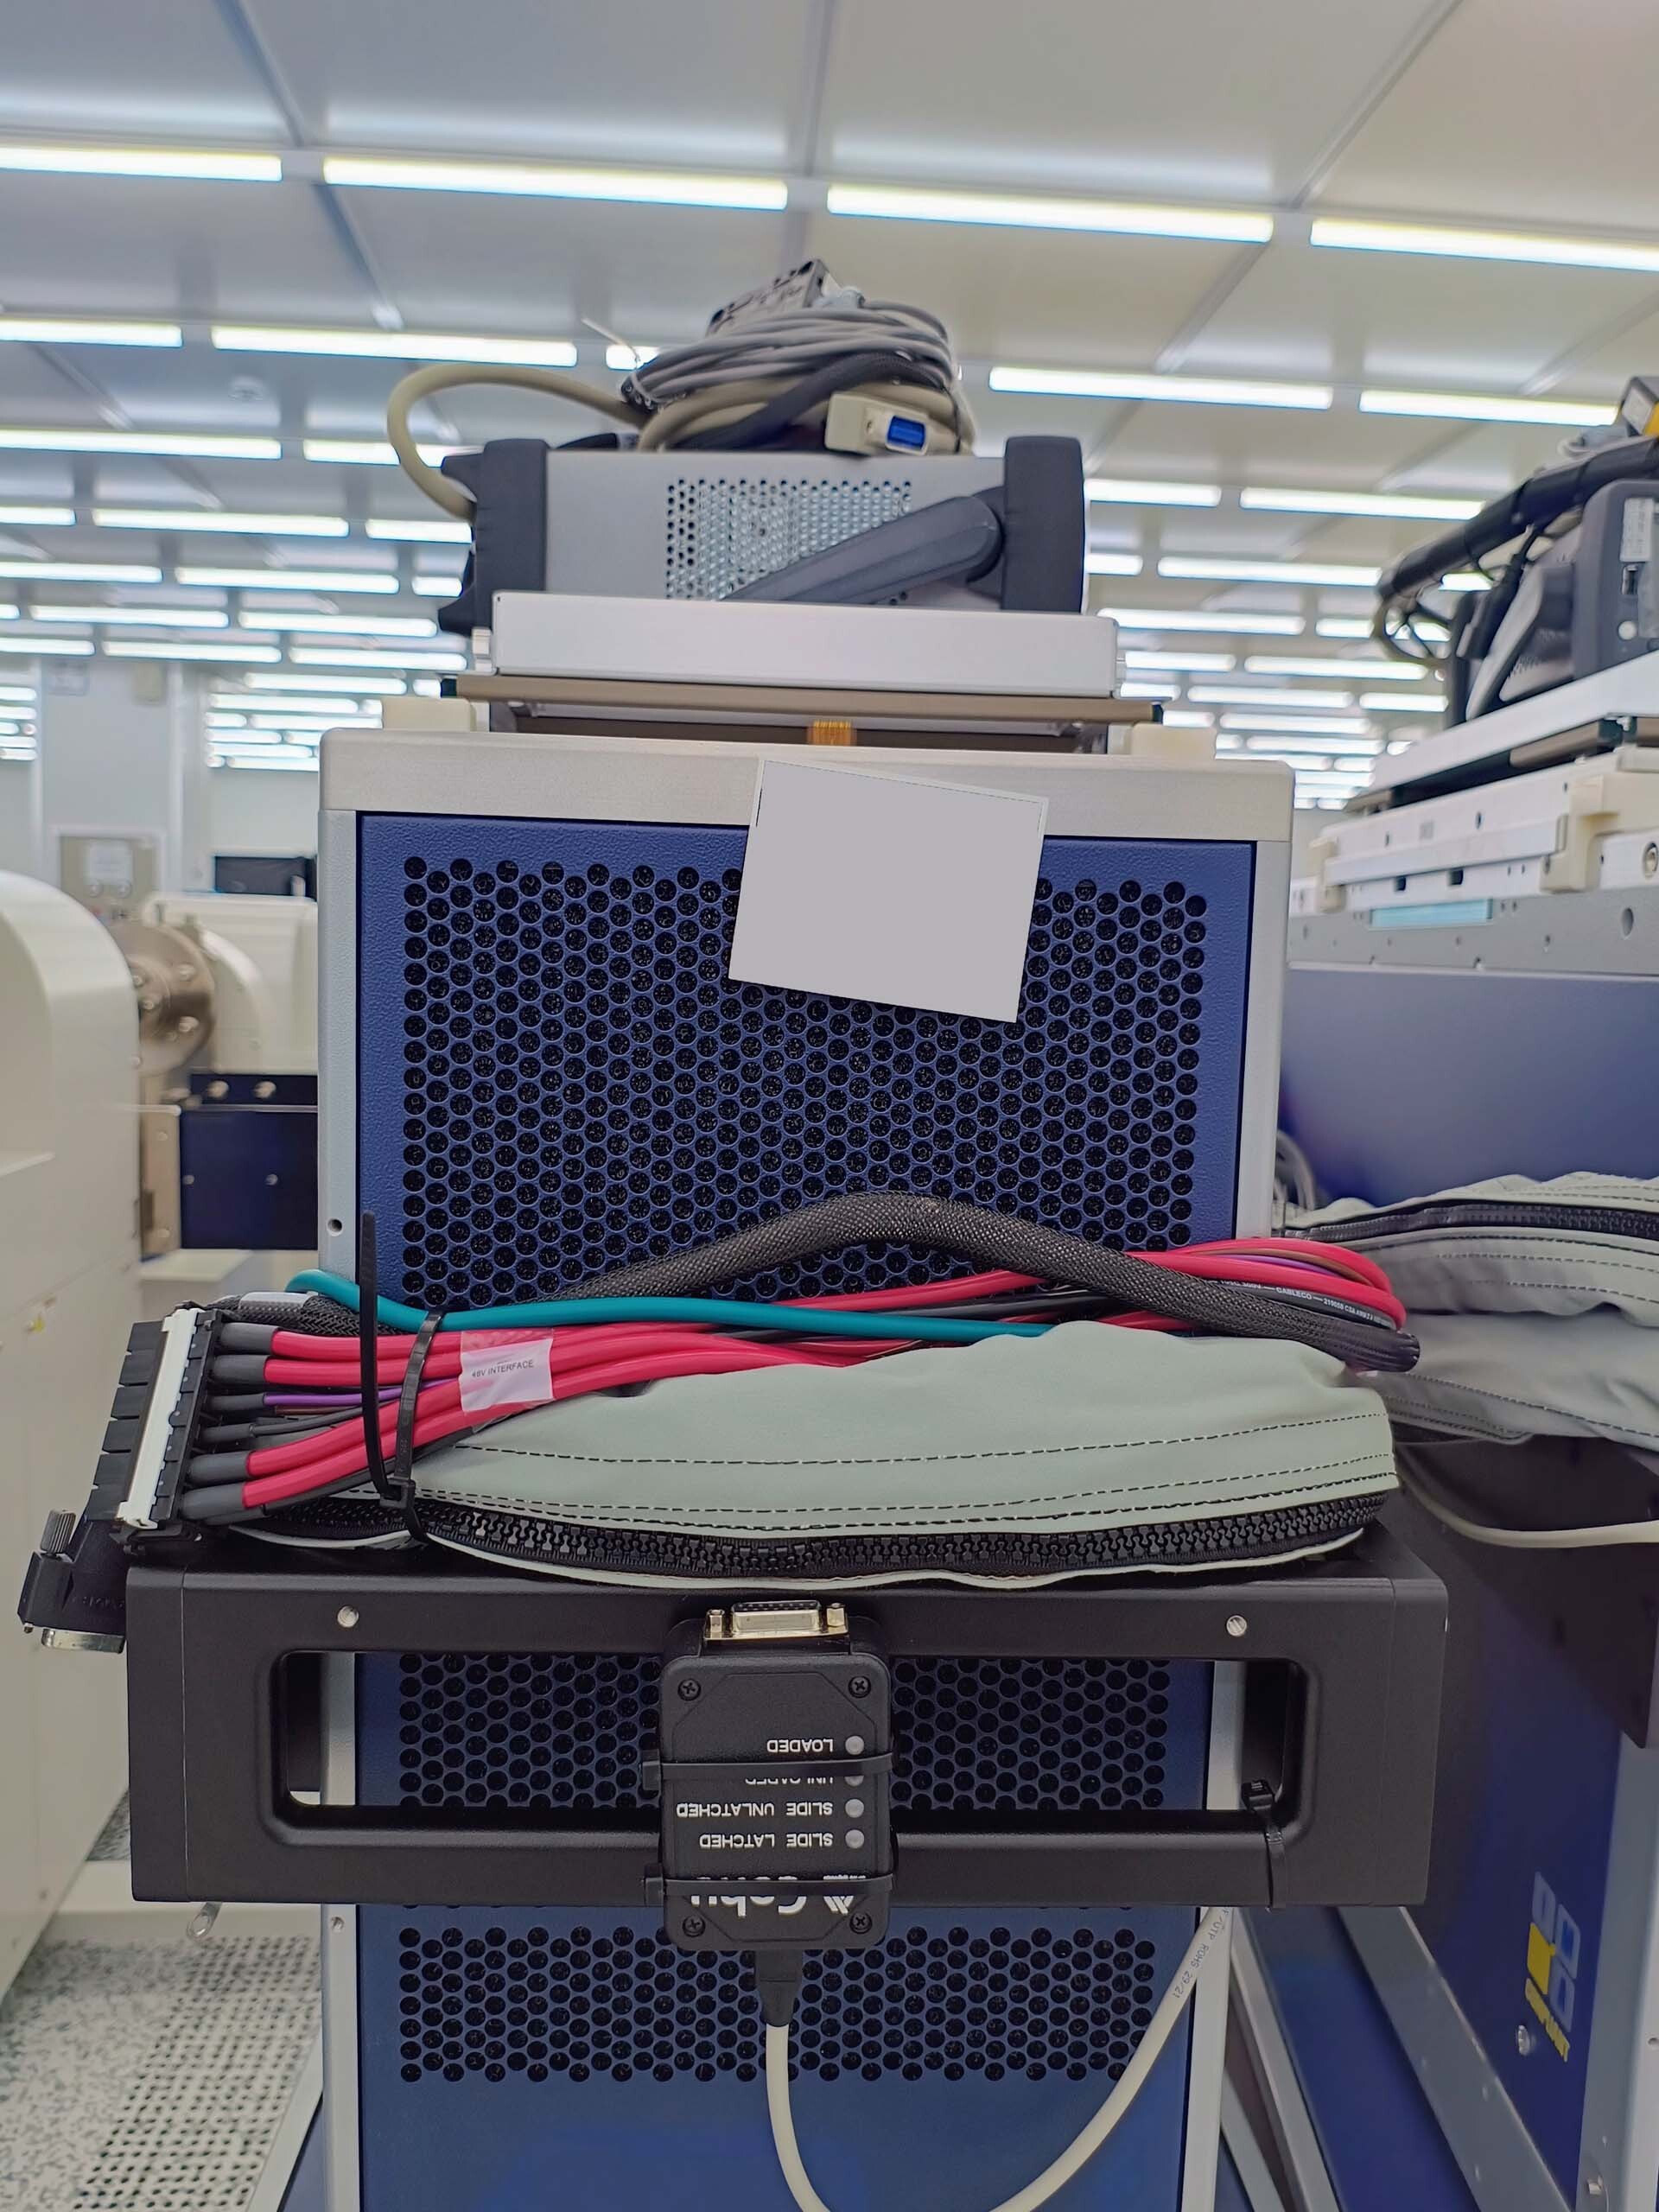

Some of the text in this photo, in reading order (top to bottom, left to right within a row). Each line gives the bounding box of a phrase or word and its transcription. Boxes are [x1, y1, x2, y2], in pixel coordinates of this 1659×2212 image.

[487, 1359, 534, 1376] INTERFACE
[766, 1738, 834, 1753] LOADED
[676, 1802, 833, 1817] SLIDE UNLATCHED
[699, 1832, 833, 1848] SLIDE LATCHED
